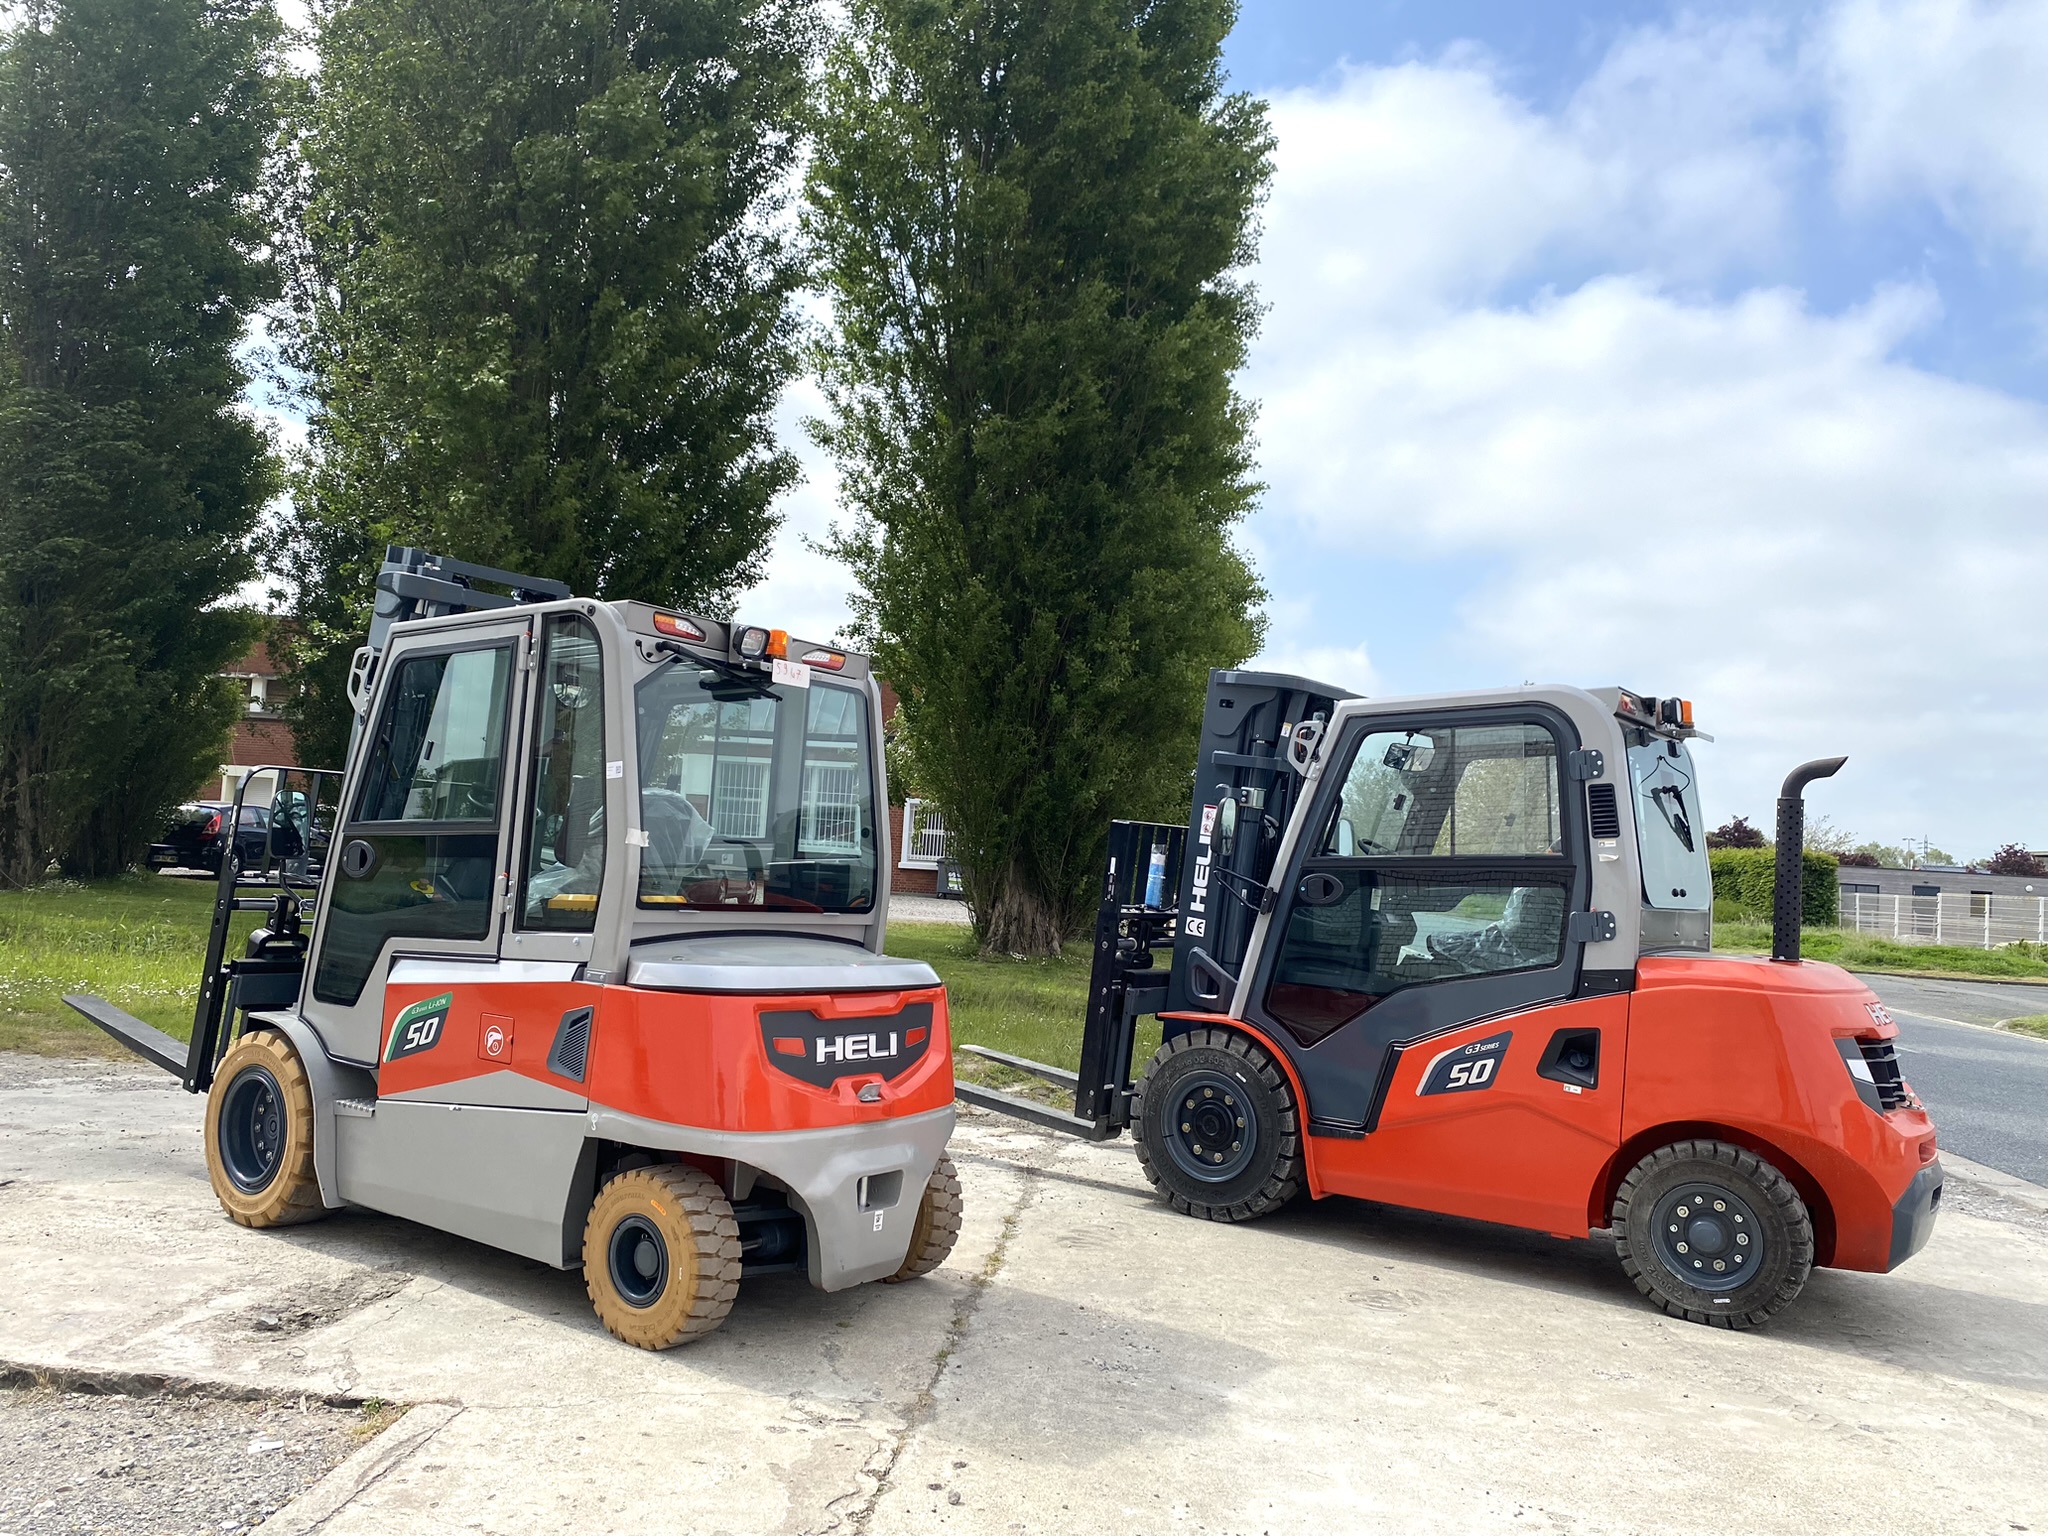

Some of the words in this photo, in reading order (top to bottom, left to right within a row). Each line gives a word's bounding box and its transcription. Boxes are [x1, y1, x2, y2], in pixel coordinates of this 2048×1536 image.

[1190, 834, 1212, 912] HELI
[1188, 919, 1205, 935] CE
[403, 1016, 440, 1050] 50
[816, 1031, 898, 1064] HELI
[1465, 1044, 1481, 1054] G3
[1480, 1042, 1500, 1051] SERIES
[1446, 1058, 1495, 1088] 50
